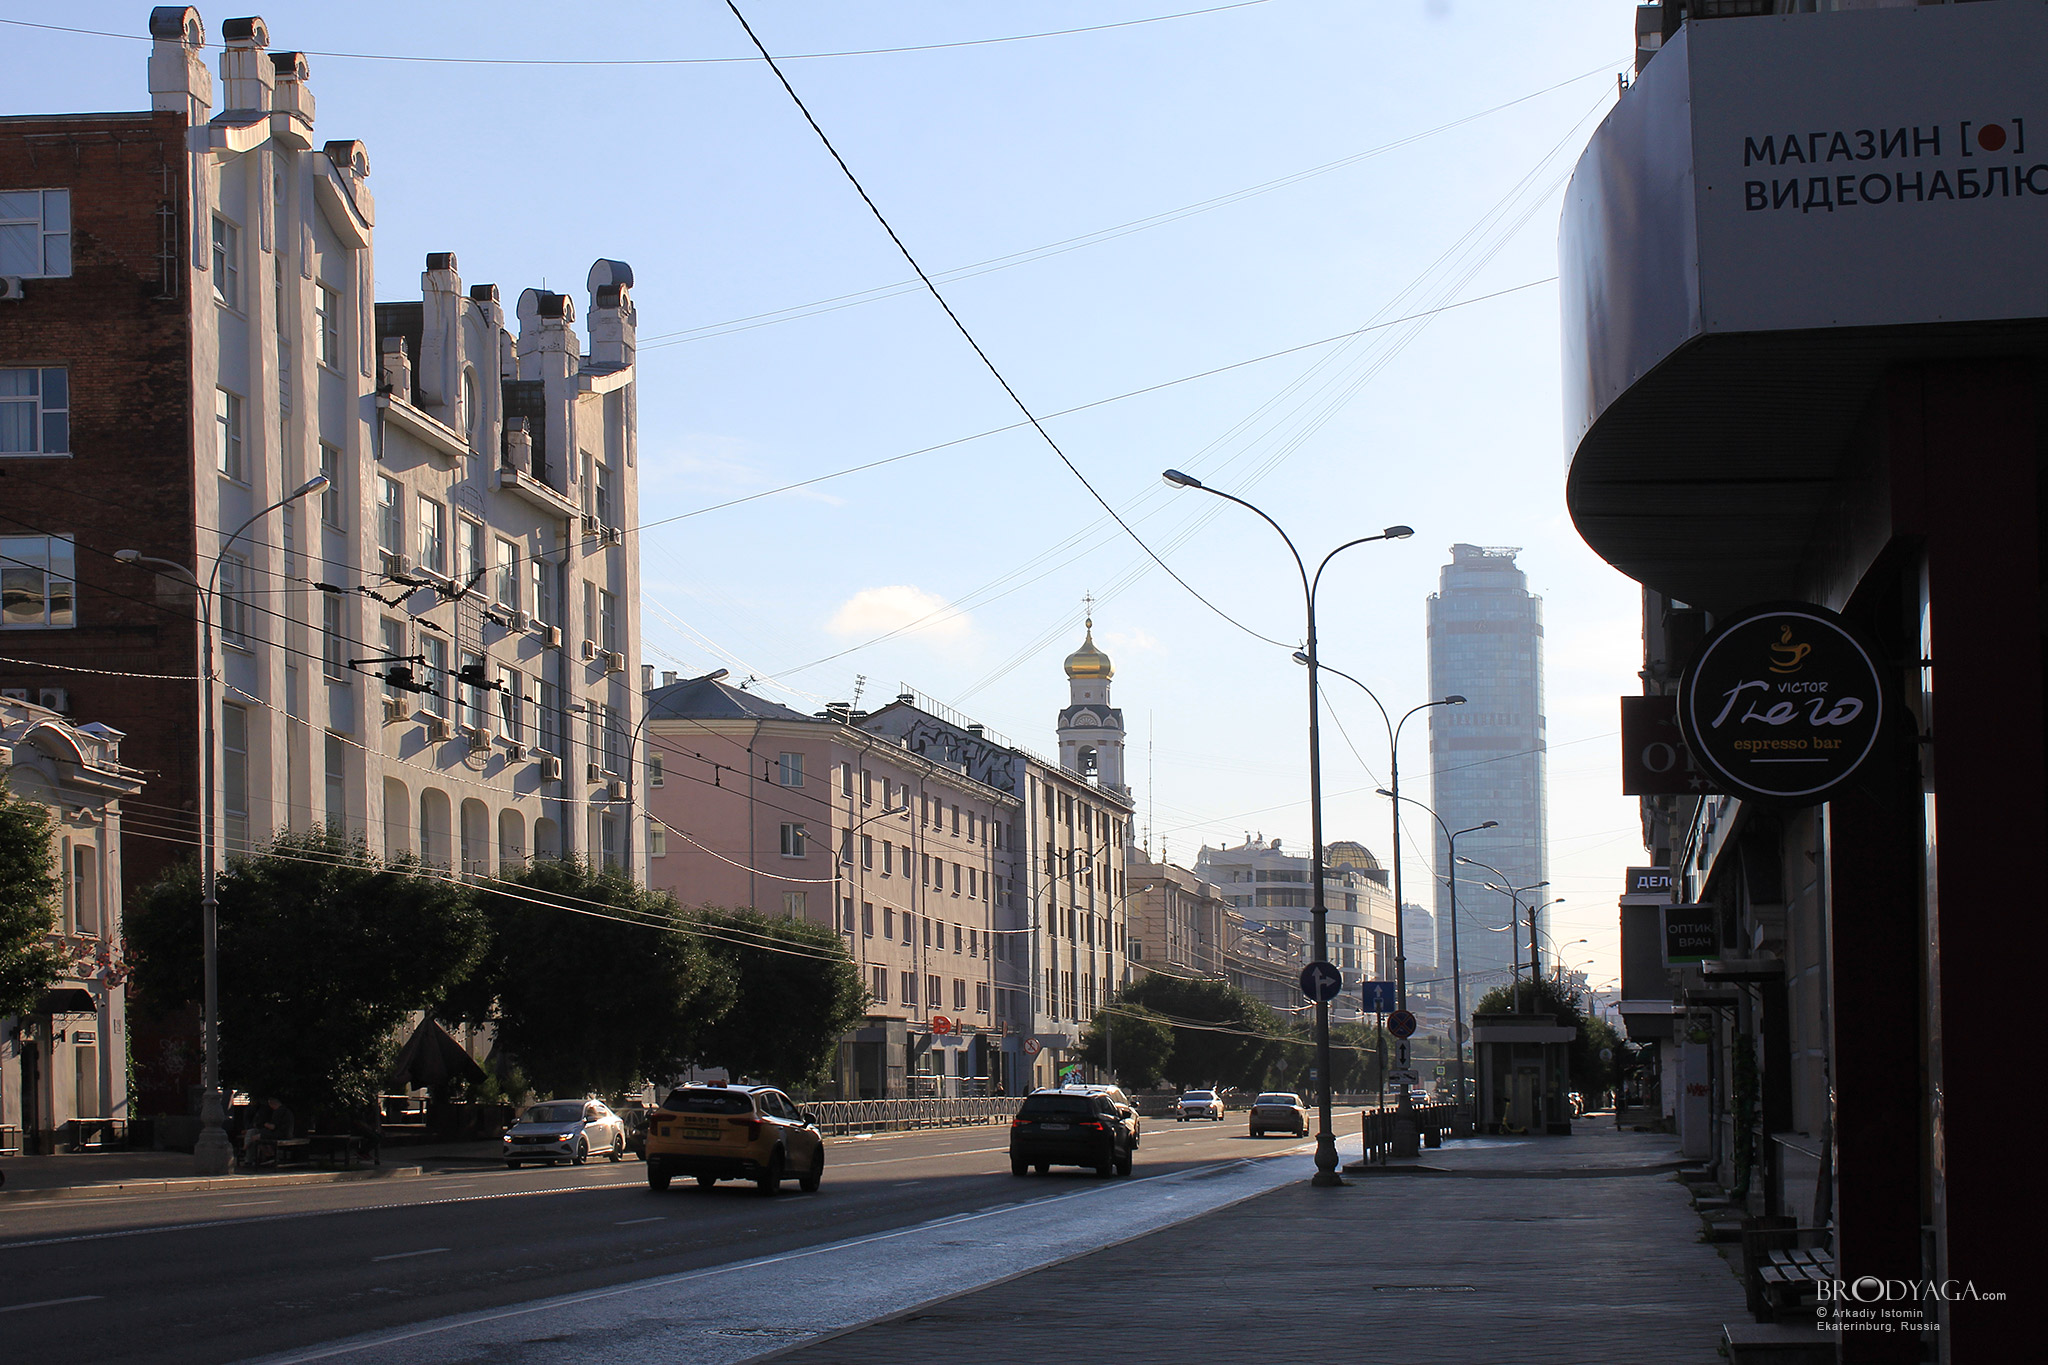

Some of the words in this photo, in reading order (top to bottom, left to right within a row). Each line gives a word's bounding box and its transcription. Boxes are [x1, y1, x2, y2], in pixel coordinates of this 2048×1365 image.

[1743, 125, 1941, 167] МАГАЗИН
[1777, 681, 1829, 694] VICTOR
[1733, 739, 1808, 753] espresso
[1813, 736, 1842, 750] bar
[1679, 937, 1711, 948] ВРАЧ
